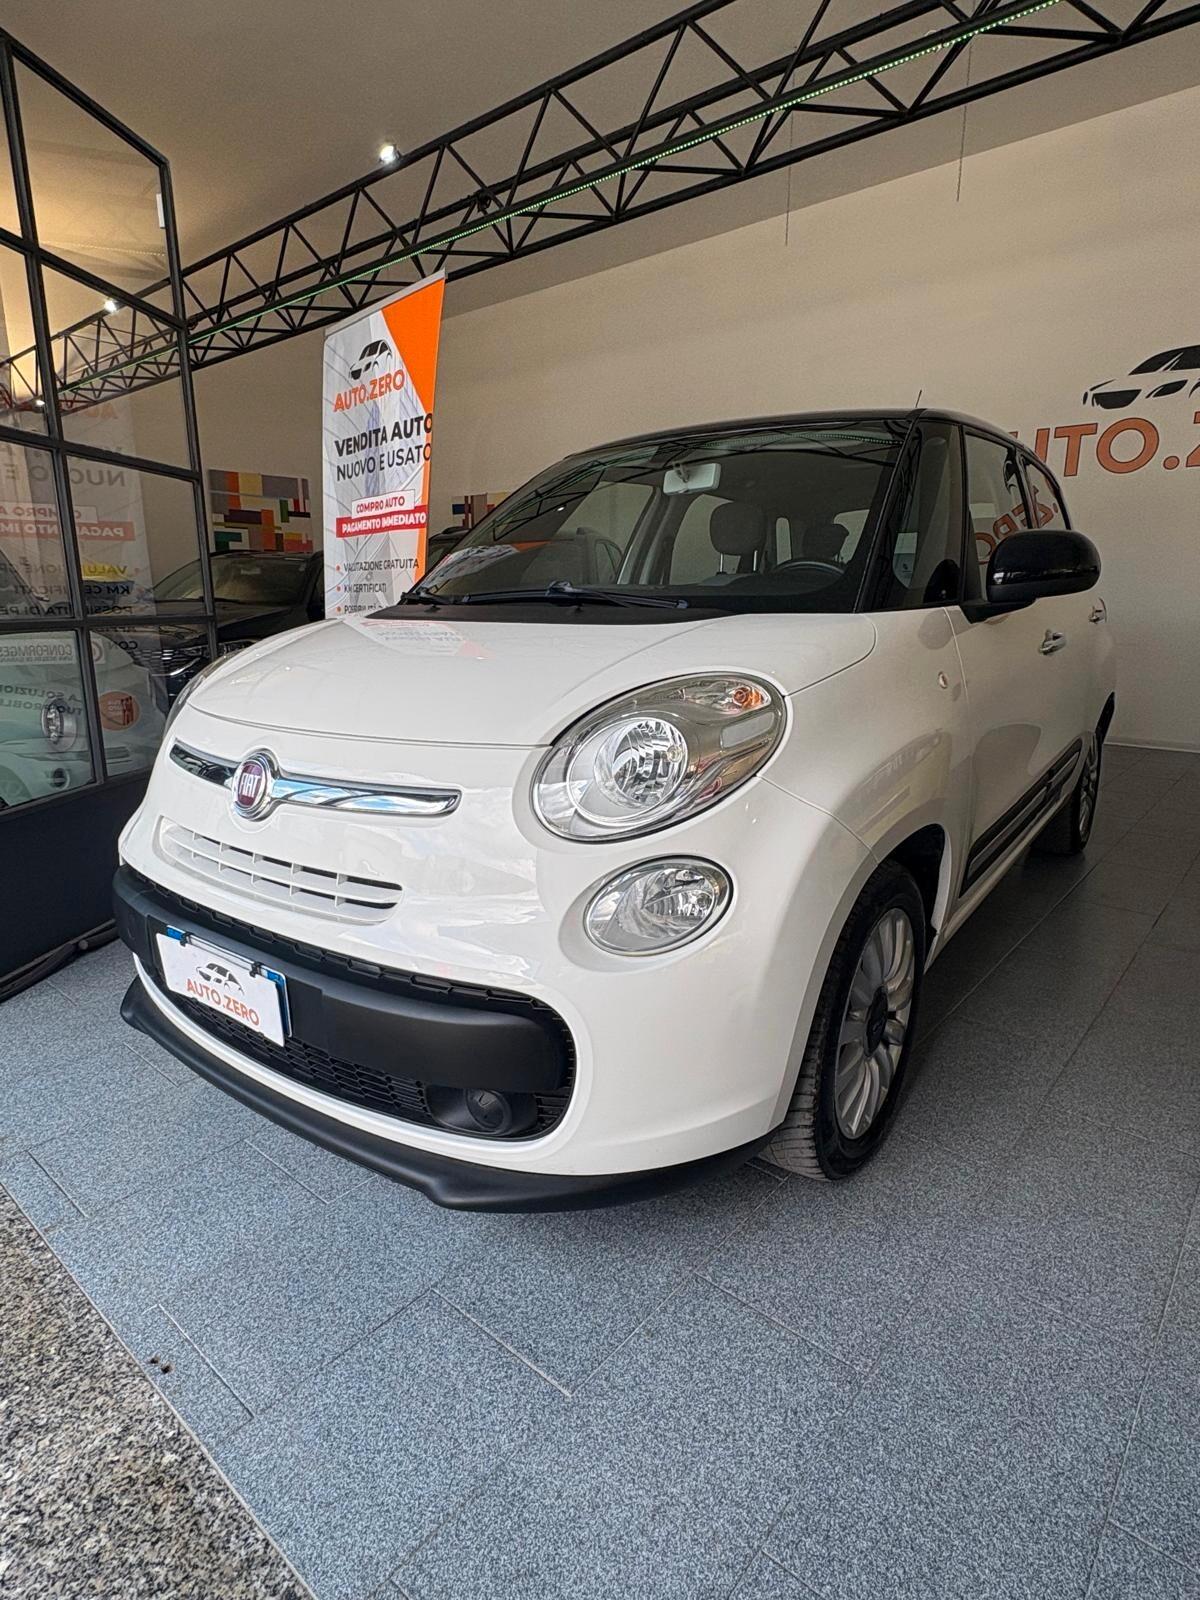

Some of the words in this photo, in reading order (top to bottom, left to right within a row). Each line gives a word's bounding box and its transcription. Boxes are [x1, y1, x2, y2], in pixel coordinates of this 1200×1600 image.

[333, 369, 405, 412] AUTO.ZERO
[334, 425, 388, 457] VENDITA
[390, 413, 433, 442] AUTO
[336, 456, 376, 481] NUOVO
[379, 453, 385, 471] E
[388, 443, 431, 468] USATO
[356, 500, 384, 514] COMPRO
[385, 496, 405, 509] AUTO
[342, 518, 381, 533] PAGAMENTO
[381, 511, 427, 528] IMMEDIATO
[383, 558, 420, 569] GRATUITA
[353, 583, 387, 593] CERTIFICATI
[241, 772, 261, 798] FIAT
[186, 978, 260, 1026] AUTO.ZERO
